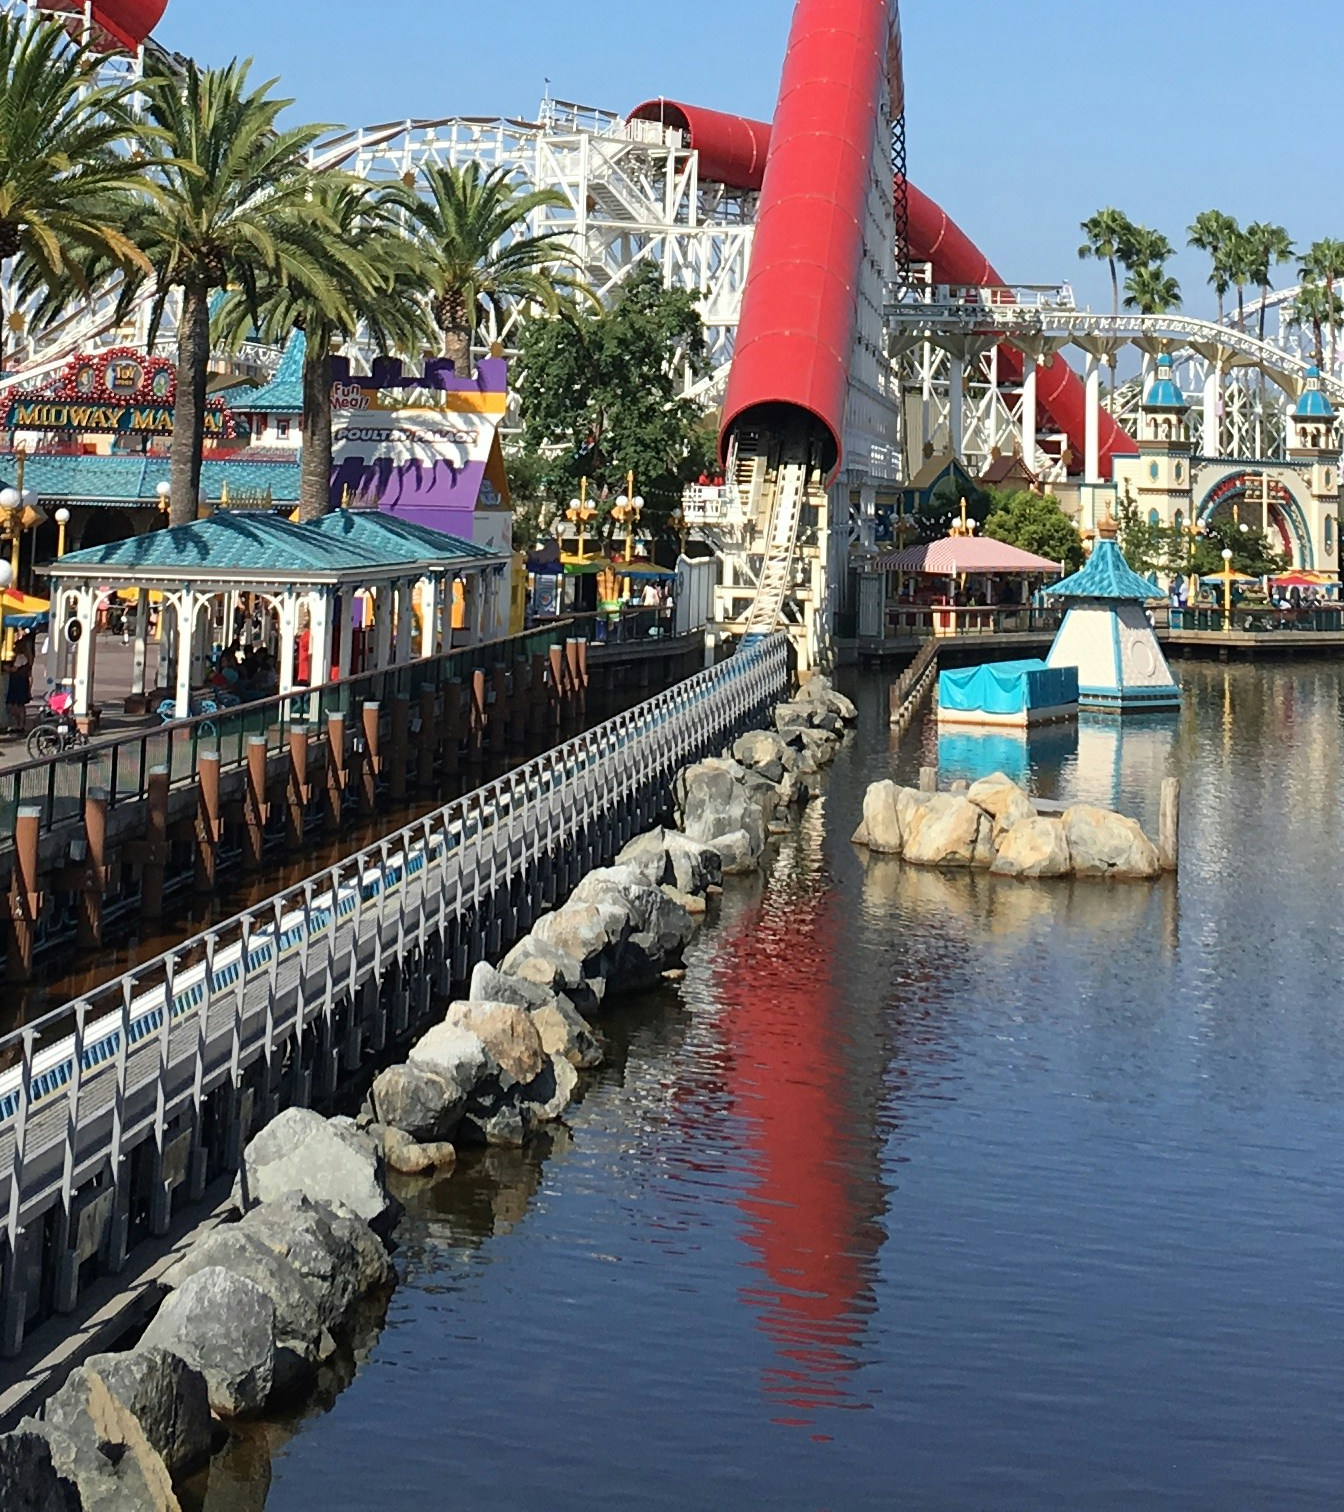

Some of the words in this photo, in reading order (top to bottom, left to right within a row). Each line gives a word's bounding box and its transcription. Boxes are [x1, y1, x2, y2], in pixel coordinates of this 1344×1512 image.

[116, 364, 137, 378] TOY
[333, 381, 361, 398] Fun
[329, 397, 371, 410] Meal!
[14, 404, 124, 426] MIDWAY
[130, 408, 223, 432] MAA!
[335, 427, 412, 442] POULTRY
